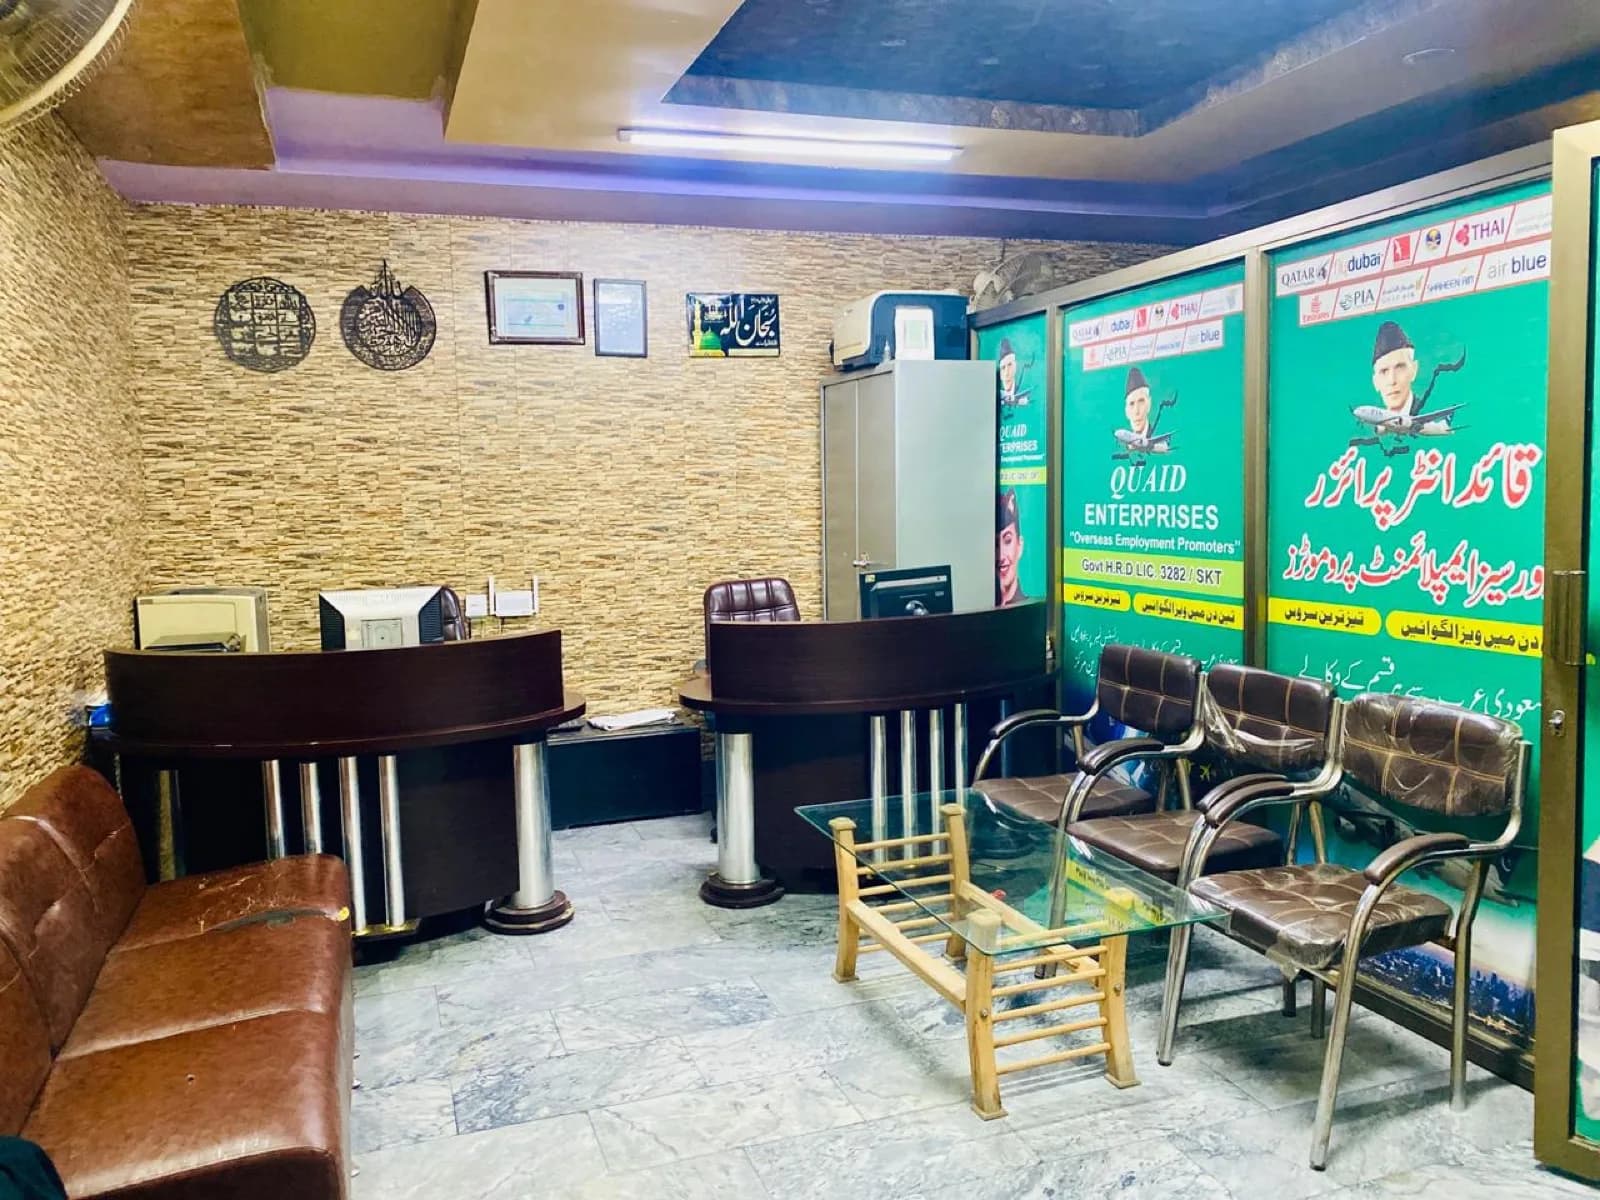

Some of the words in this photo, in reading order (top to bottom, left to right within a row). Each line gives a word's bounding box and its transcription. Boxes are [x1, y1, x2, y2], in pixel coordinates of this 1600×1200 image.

[1472, 218, 1505, 241] THAI
[1511, 254, 1547, 274] blue
[1281, 266, 1315, 287] QATAR
[1354, 289, 1375, 305] PIA
[1200, 329, 1220, 343] blue
[1110, 464, 1187, 500] QUAID
[1084, 503, 1219, 530] ENTERPRISES
[1115, 534, 1175, 552] Employment
[1082, 558, 1104, 573] Govt
[1160, 565, 1186, 581] 3282
[1196, 568, 1222, 585] SKT
